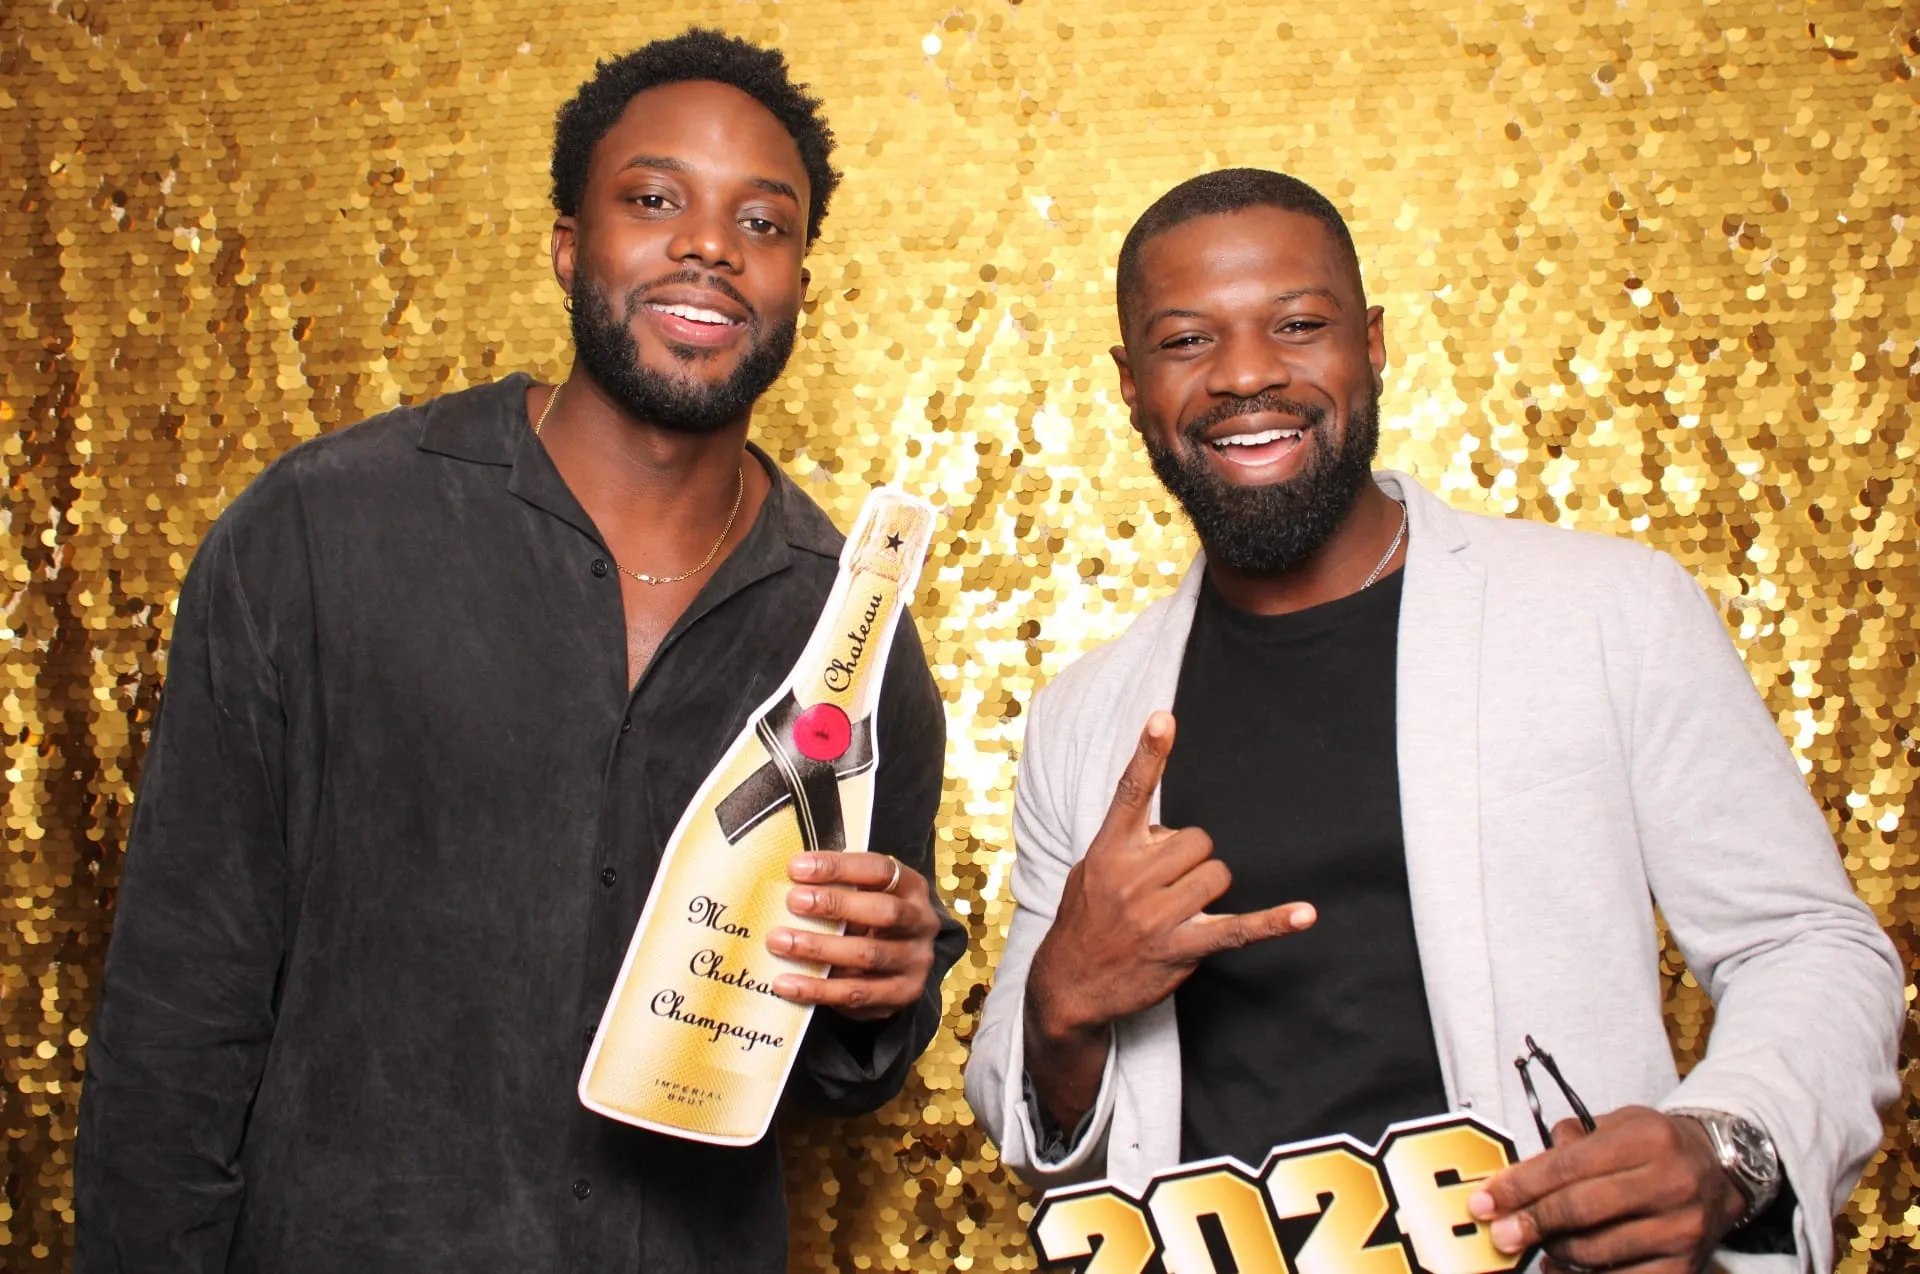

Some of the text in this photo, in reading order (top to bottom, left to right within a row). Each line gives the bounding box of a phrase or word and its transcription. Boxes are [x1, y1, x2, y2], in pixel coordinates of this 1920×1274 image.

[823, 592, 883, 693] Chateau
[687, 895, 751, 939] Mon
[650, 988, 785, 1051] Champagne
[654, 1078, 723, 1101] IMPERIAL
[666, 1092, 703, 1107] BRUT
